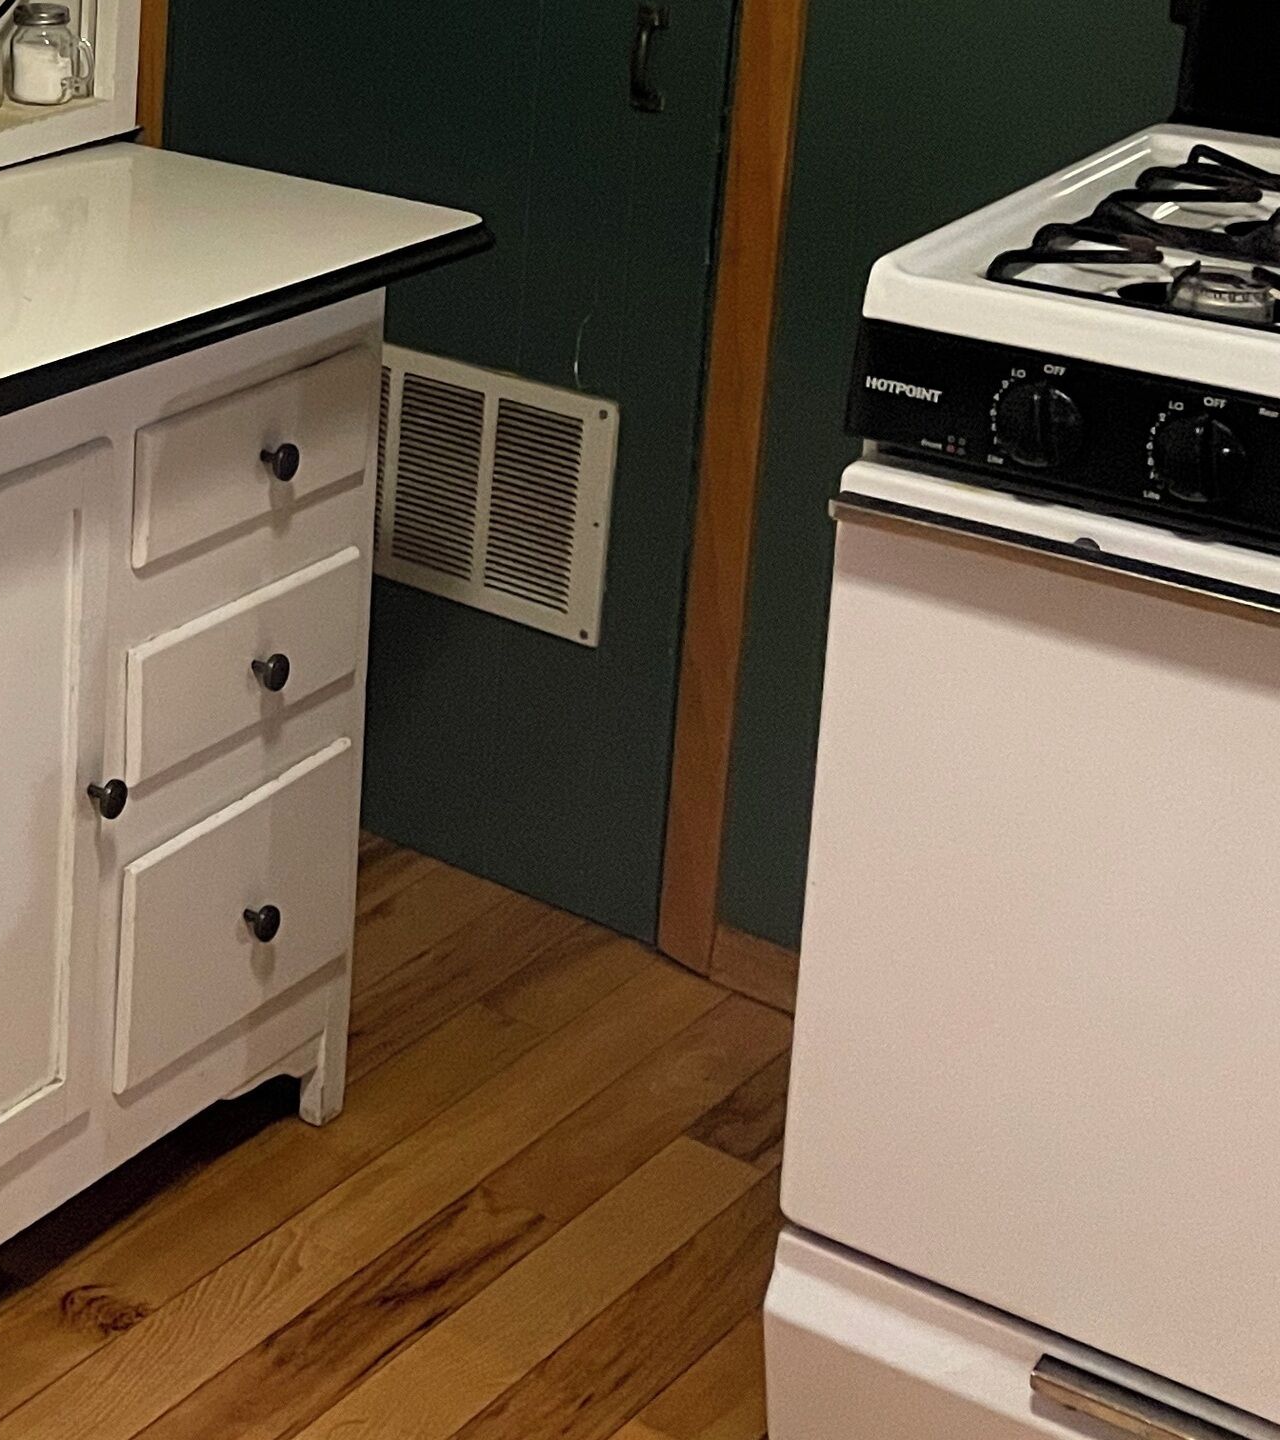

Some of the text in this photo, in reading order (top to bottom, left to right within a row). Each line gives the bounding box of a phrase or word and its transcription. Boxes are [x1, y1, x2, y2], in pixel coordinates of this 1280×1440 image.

[1011, 364, 1066, 378] LO OFF
[866, 376, 942, 403] HOTPOINT
[1168, 396, 1227, 411] LO OFF
